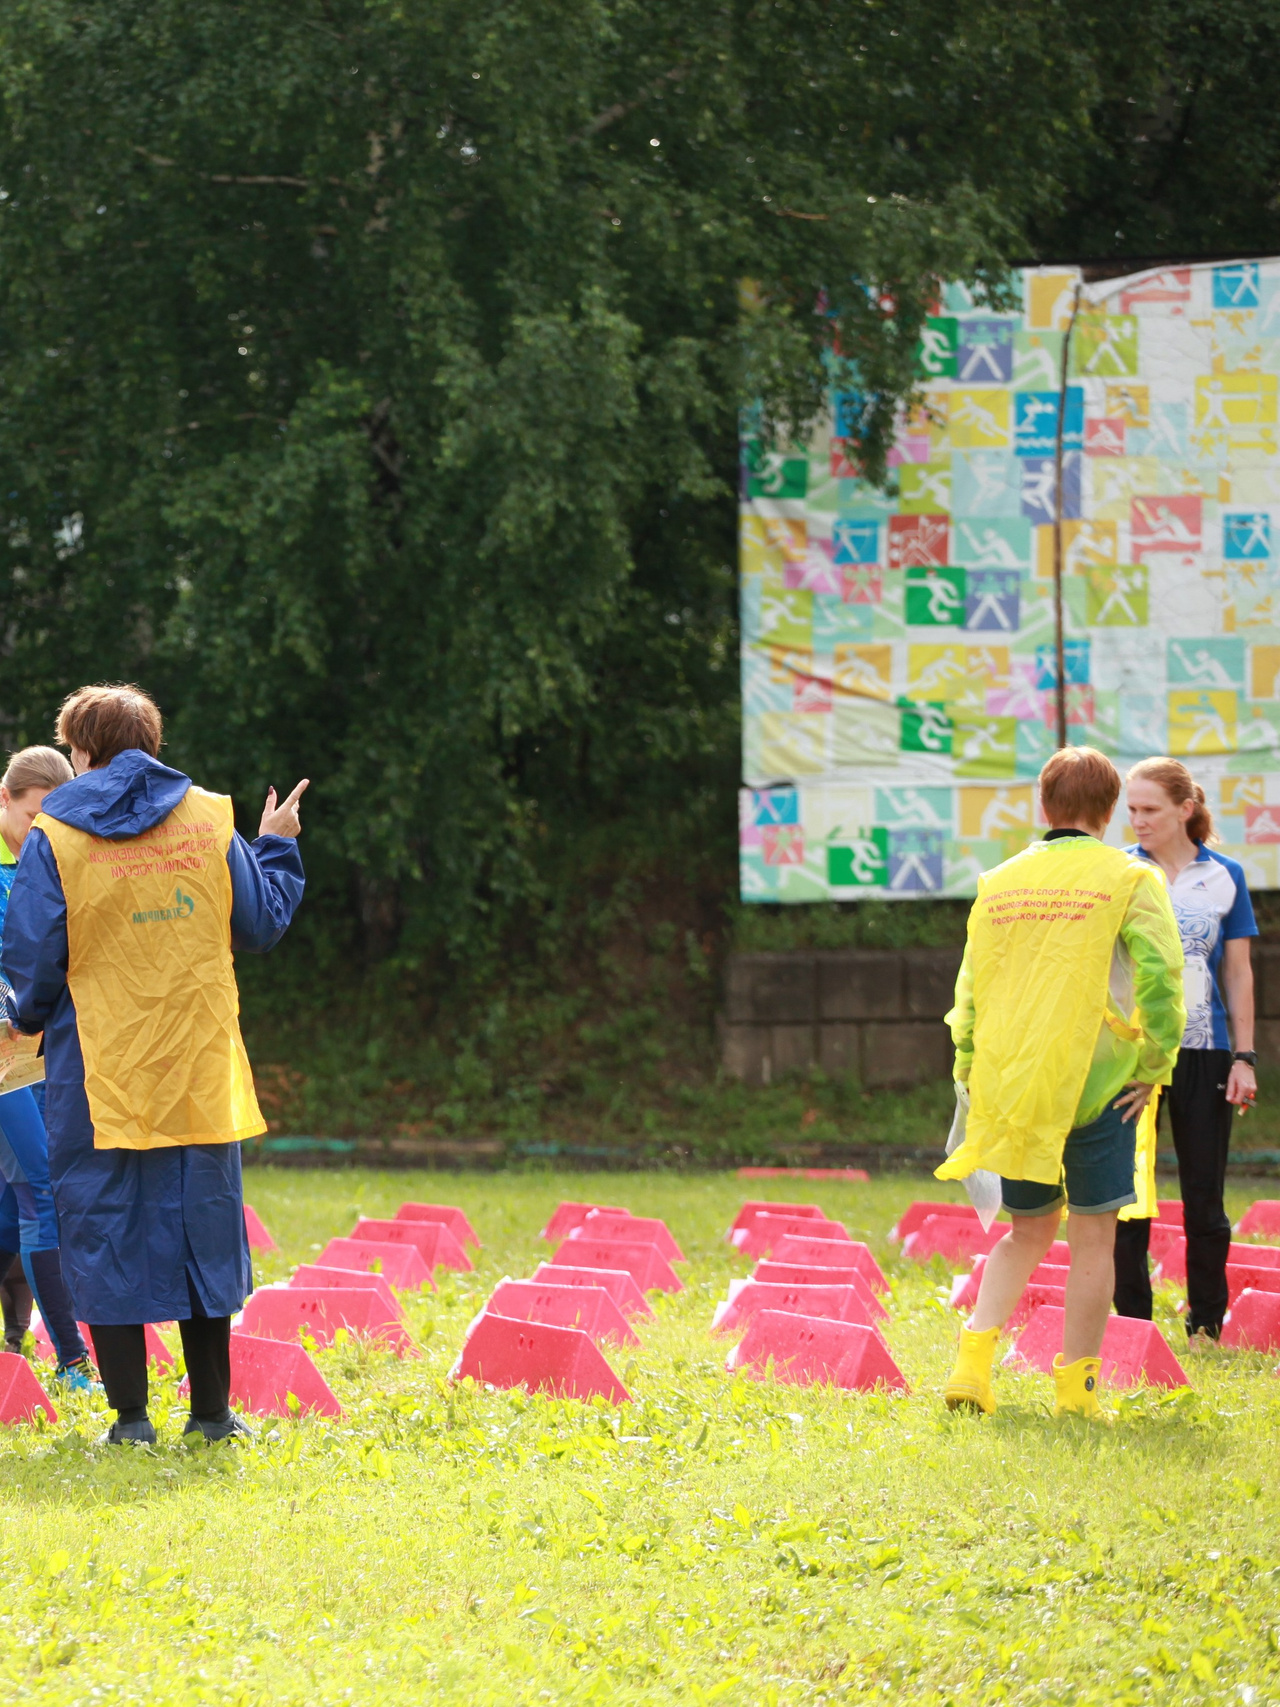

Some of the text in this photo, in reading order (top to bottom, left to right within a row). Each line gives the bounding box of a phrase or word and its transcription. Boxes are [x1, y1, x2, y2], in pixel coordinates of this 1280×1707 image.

[1036, 888, 1071, 896] СПОРТА
[1074, 889, 1112, 902] ТУРИЗМА
[988, 906, 994, 914] И
